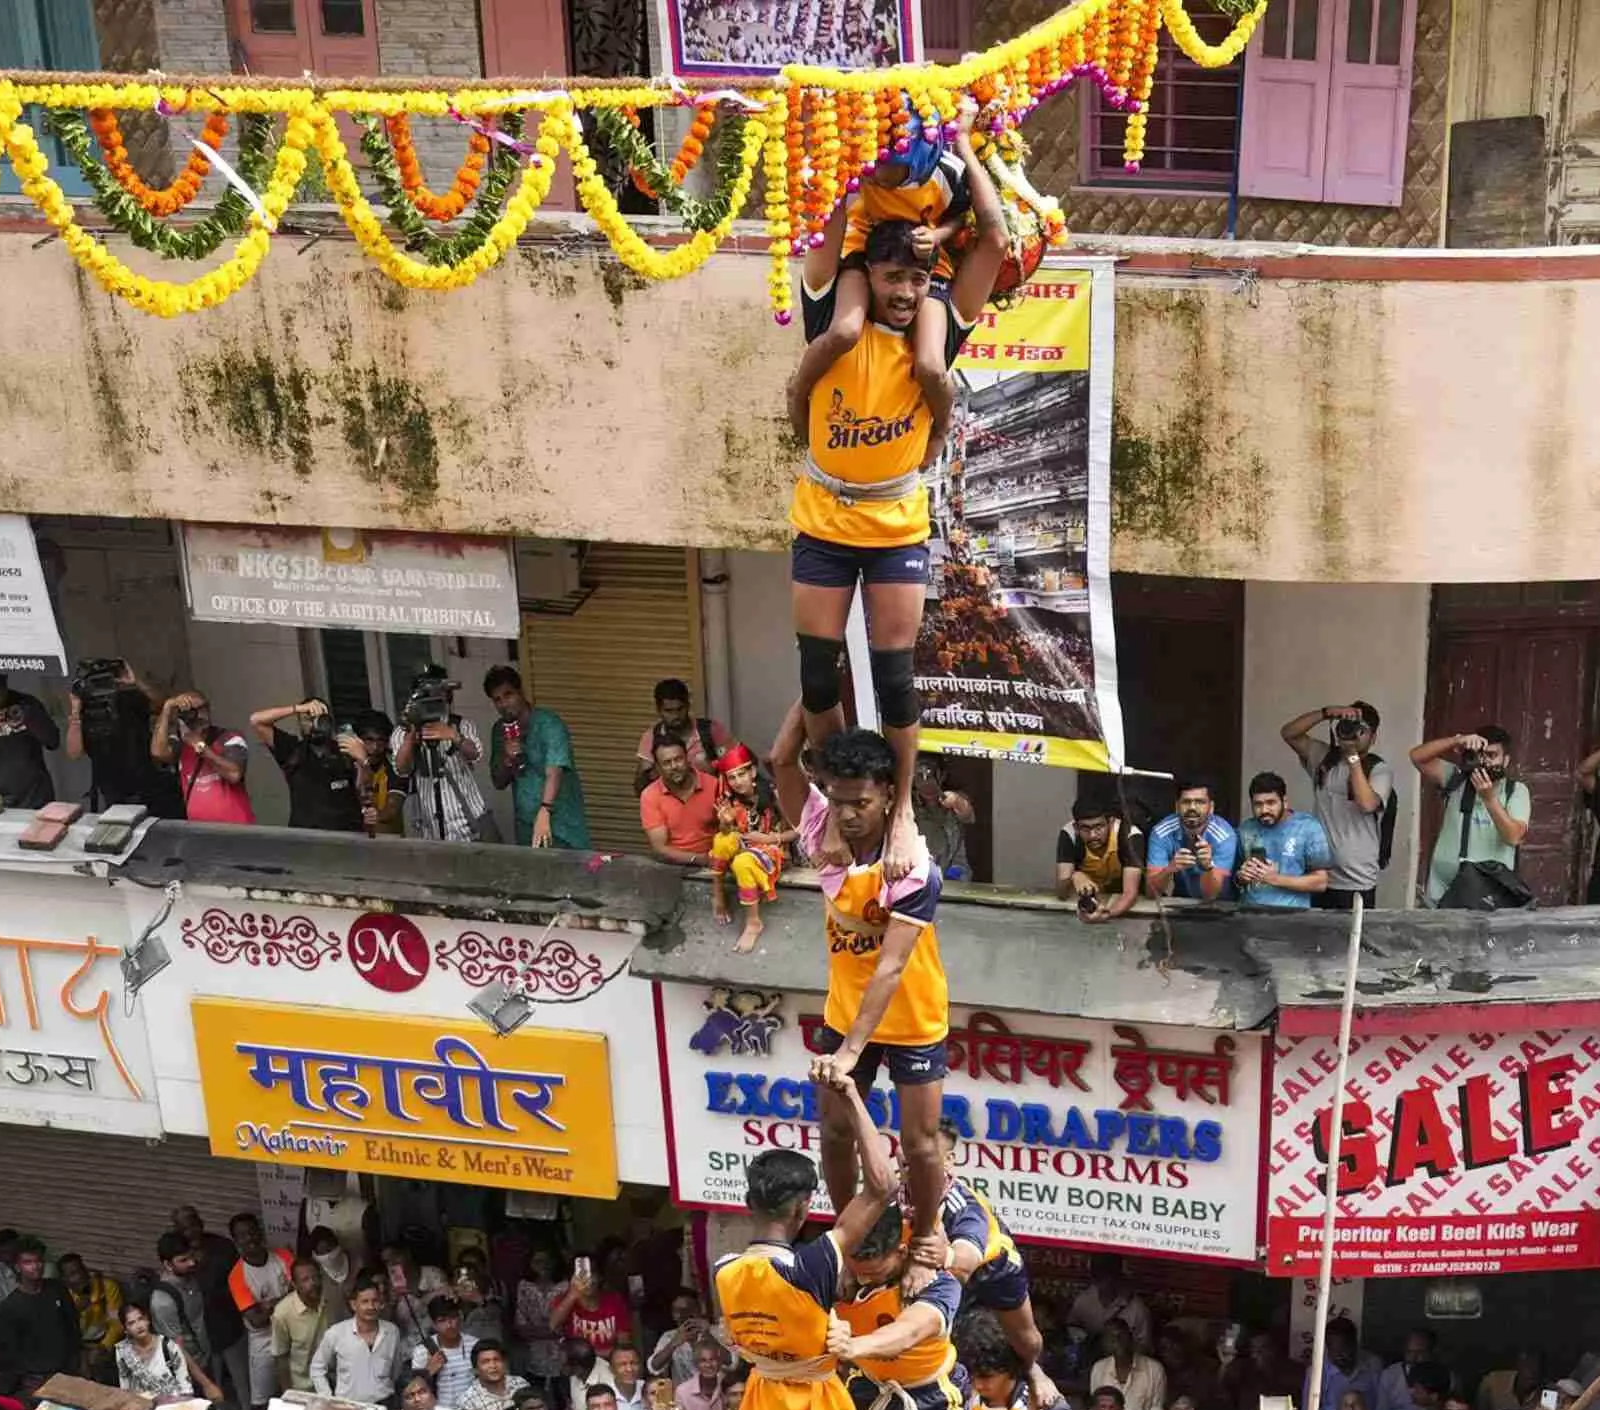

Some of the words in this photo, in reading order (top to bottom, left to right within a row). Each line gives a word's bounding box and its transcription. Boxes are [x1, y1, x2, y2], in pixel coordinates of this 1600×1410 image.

[211, 595, 265, 615] OFFICE
[268, 597, 289, 616] OF
[292, 599, 325, 618] THE
[329, 602, 411, 624] ARBITRAL
[411, 607, 496, 628] TRIBUNAL
[235, 1036, 567, 1133] महावीर
[986, 1099, 1223, 1162] DRAPERS
[1313, 1054, 1580, 1194] SALE
[235, 1119, 349, 1157] Mahavir
[365, 1139, 432, 1168] Ethnic
[437, 1148, 457, 1169] &
[463, 1150, 521, 1177] Men's
[523, 1153, 576, 1183] Wear
[951, 1141, 1190, 1189] UNIFORMS
[999, 1181, 1059, 1204] NEW
[1067, 1187, 1143, 1213] BORN
[1151, 1196, 1227, 1223] BABY
[1015, 1207, 1033, 1218] TO
[1035, 1209, 1097, 1225] COLLECT
[1102, 1217, 1128, 1229] TAX
[1130, 1220, 1150, 1231] ON
[1154, 1223, 1221, 1240] SUPPLIES
[1487, 1221, 1526, 1240] Kids
[1531, 1220, 1579, 1239] Wear
